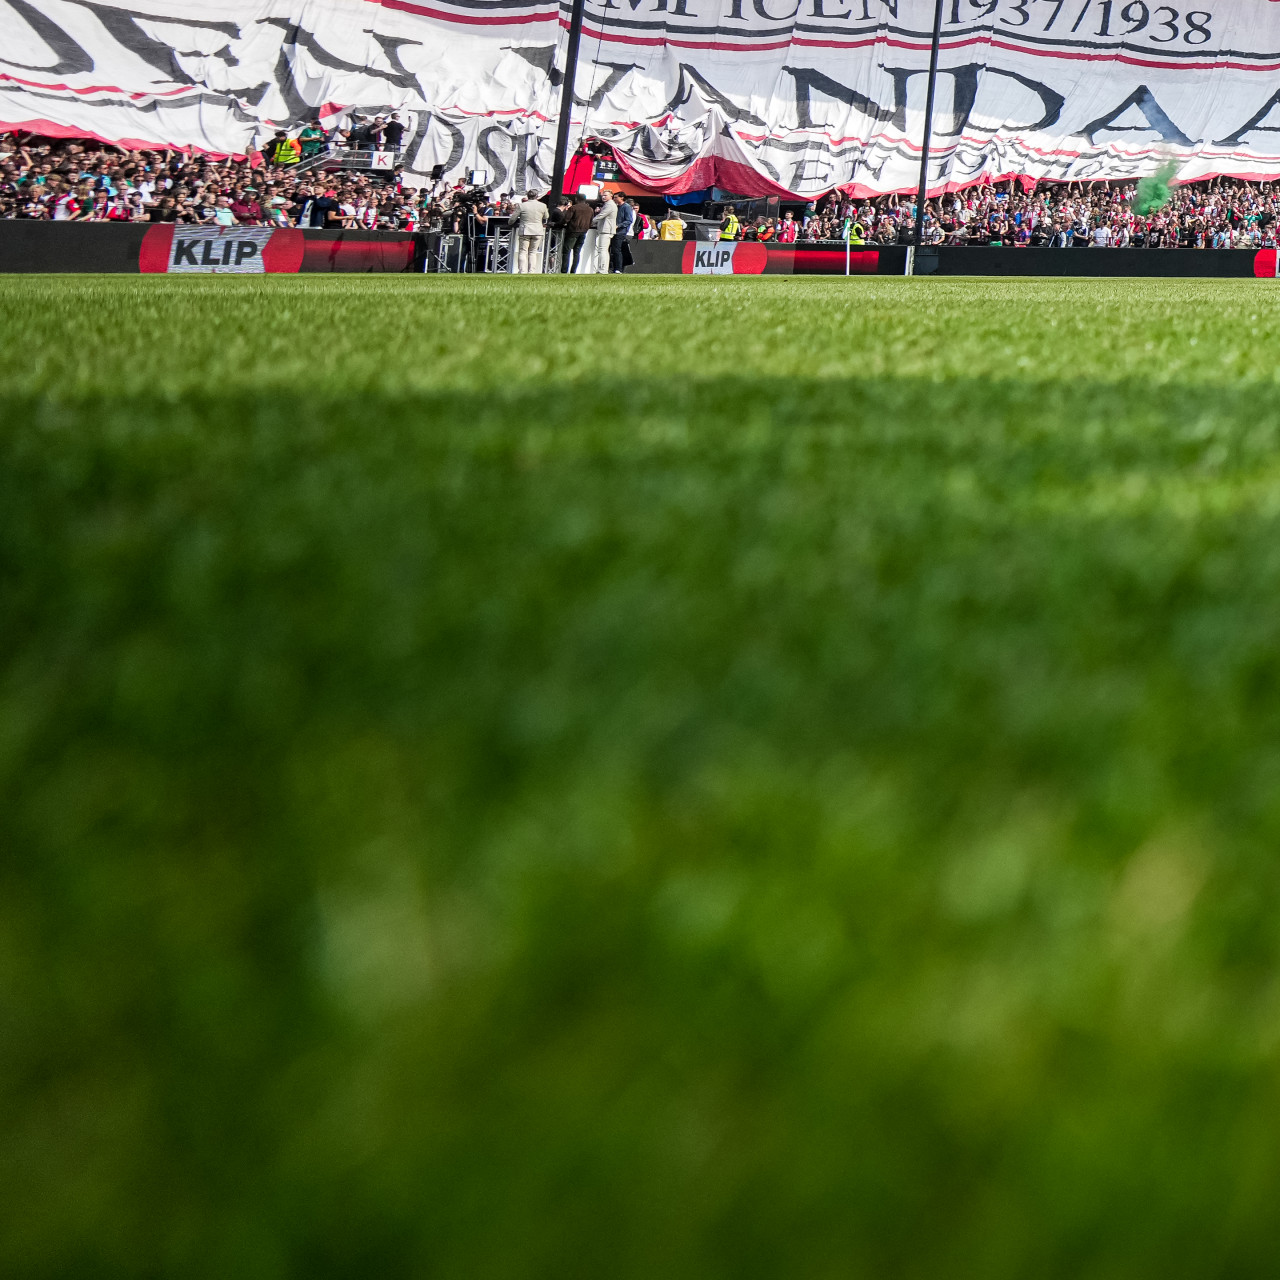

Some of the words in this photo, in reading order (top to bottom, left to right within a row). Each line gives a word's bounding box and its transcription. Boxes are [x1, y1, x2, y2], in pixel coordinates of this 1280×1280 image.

[377, 154, 388, 167] K
[174, 240, 257, 265] KLIP
[695, 250, 731, 268] KLIP
